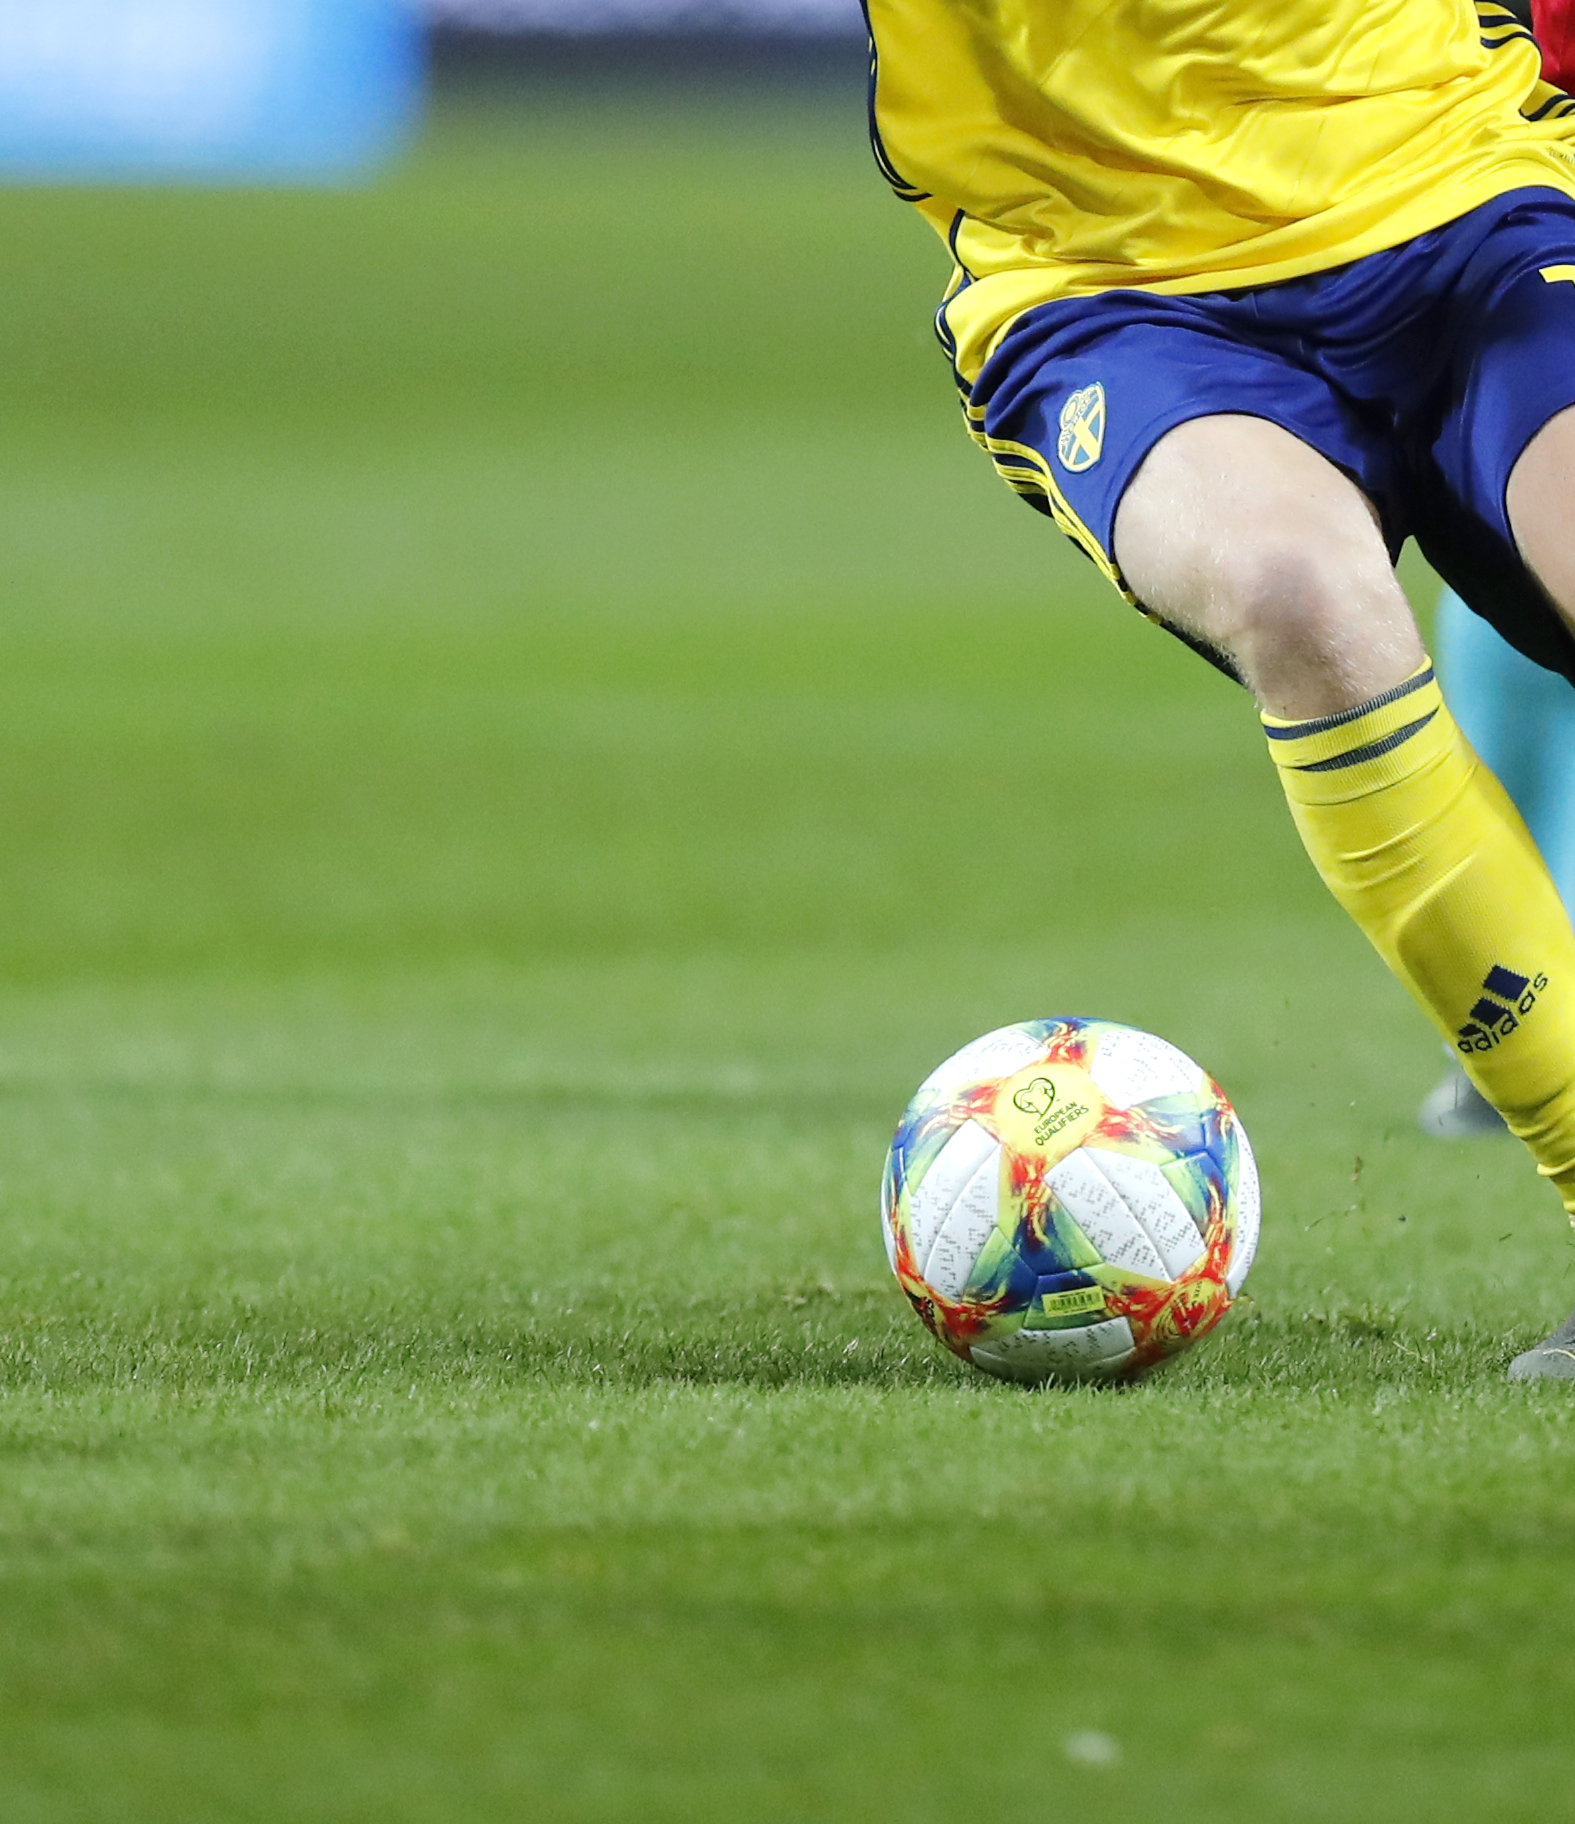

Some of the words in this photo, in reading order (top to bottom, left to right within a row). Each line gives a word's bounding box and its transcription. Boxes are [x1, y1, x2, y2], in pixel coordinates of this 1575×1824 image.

[1457, 972, 1548, 1053] adidas
[1034, 1101, 1078, 1134] EUROPEAN
[1035, 1105, 1090, 1146] QUALIFIERS
